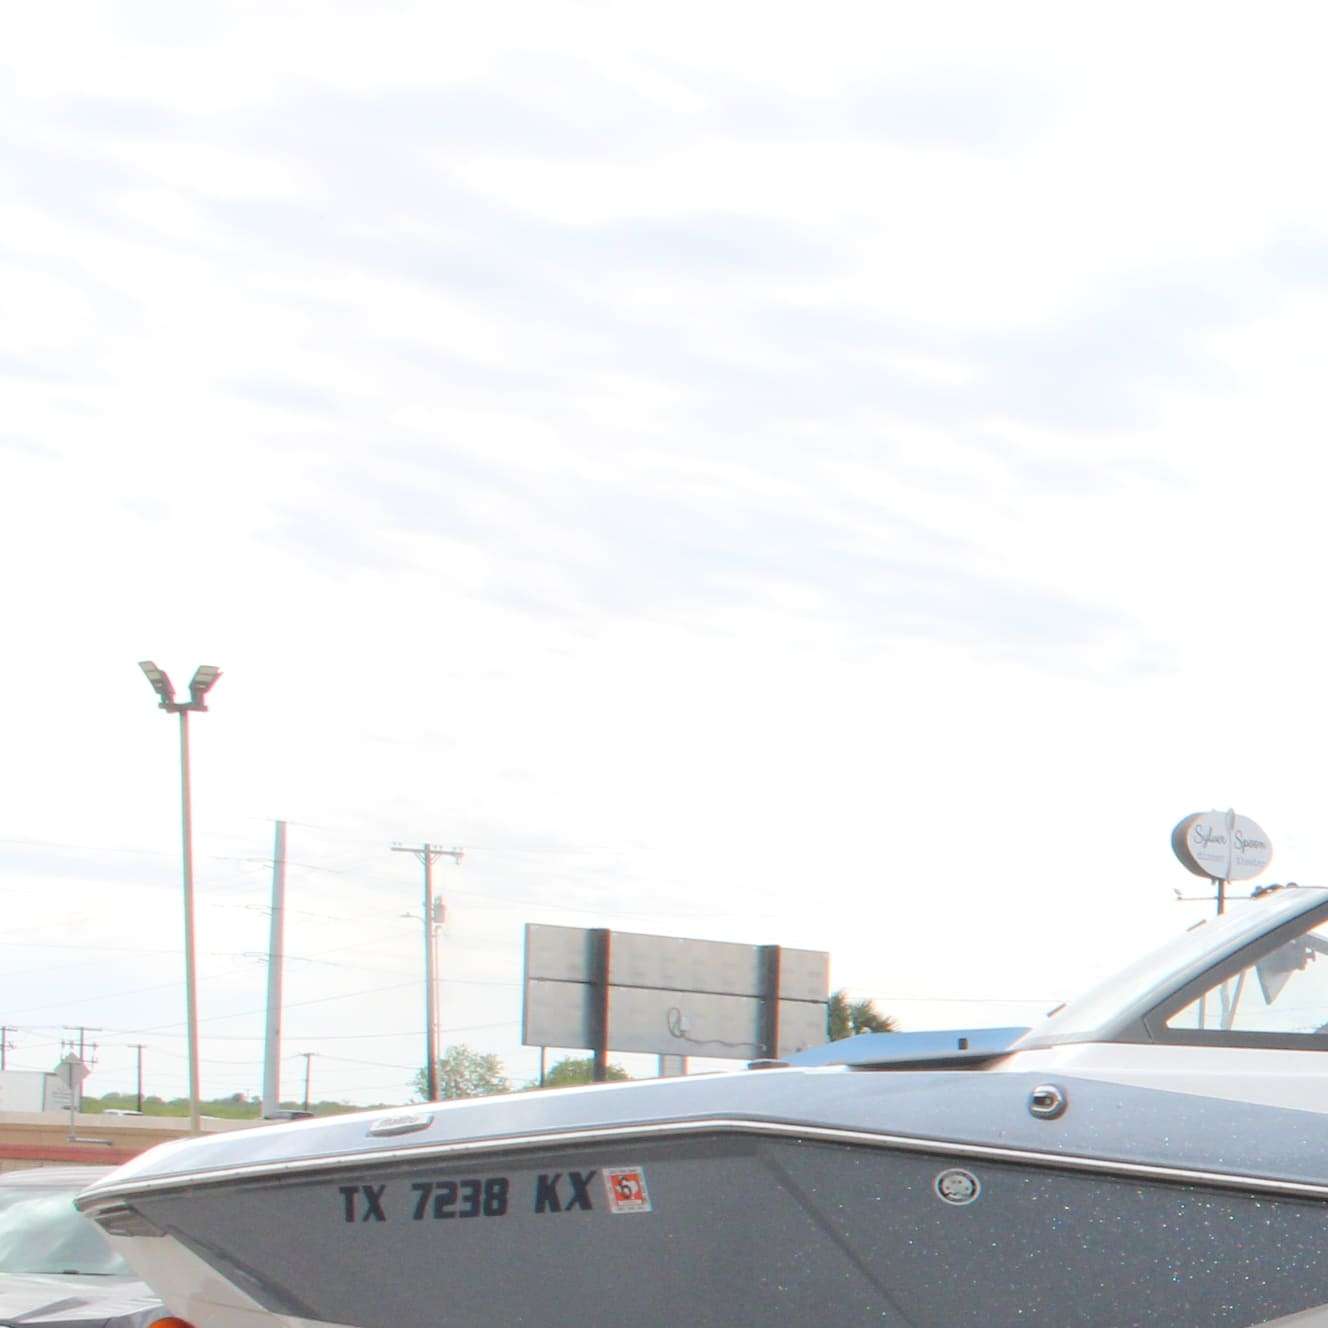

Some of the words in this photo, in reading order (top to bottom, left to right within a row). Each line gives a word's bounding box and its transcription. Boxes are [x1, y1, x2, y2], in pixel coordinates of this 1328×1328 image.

[339, 1184, 387, 1222] TX
[411, 1177, 510, 1221] 7238
[534, 1169, 597, 1214] KX
